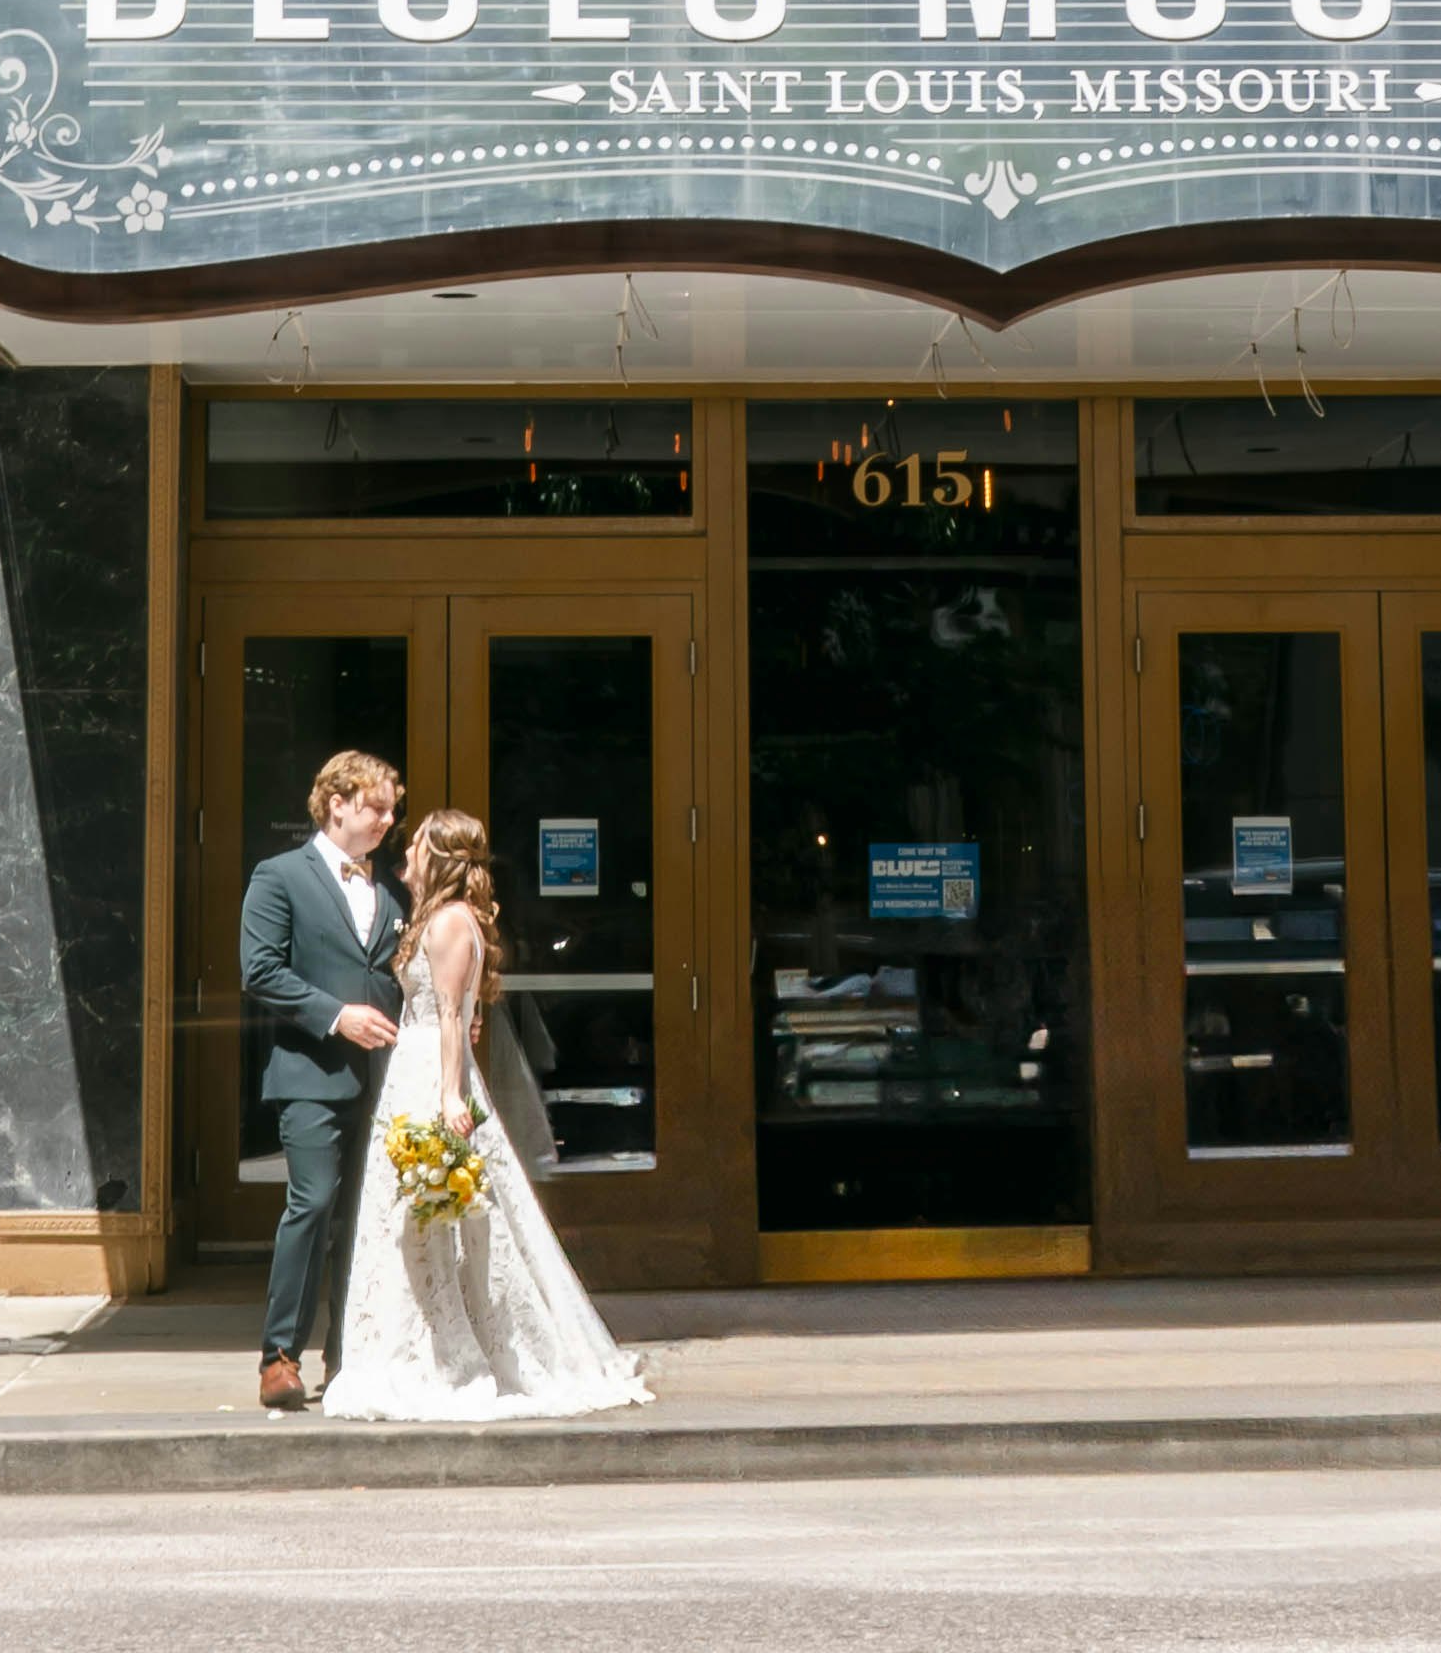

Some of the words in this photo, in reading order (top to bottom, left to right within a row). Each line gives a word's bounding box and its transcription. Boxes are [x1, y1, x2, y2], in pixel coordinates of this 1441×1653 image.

[608, 69, 802, 114] SAINT
[824, 68, 1045, 121] LOUIS,
[1070, 67, 1392, 114] MISSOURI
[853, 449, 973, 507] 615
